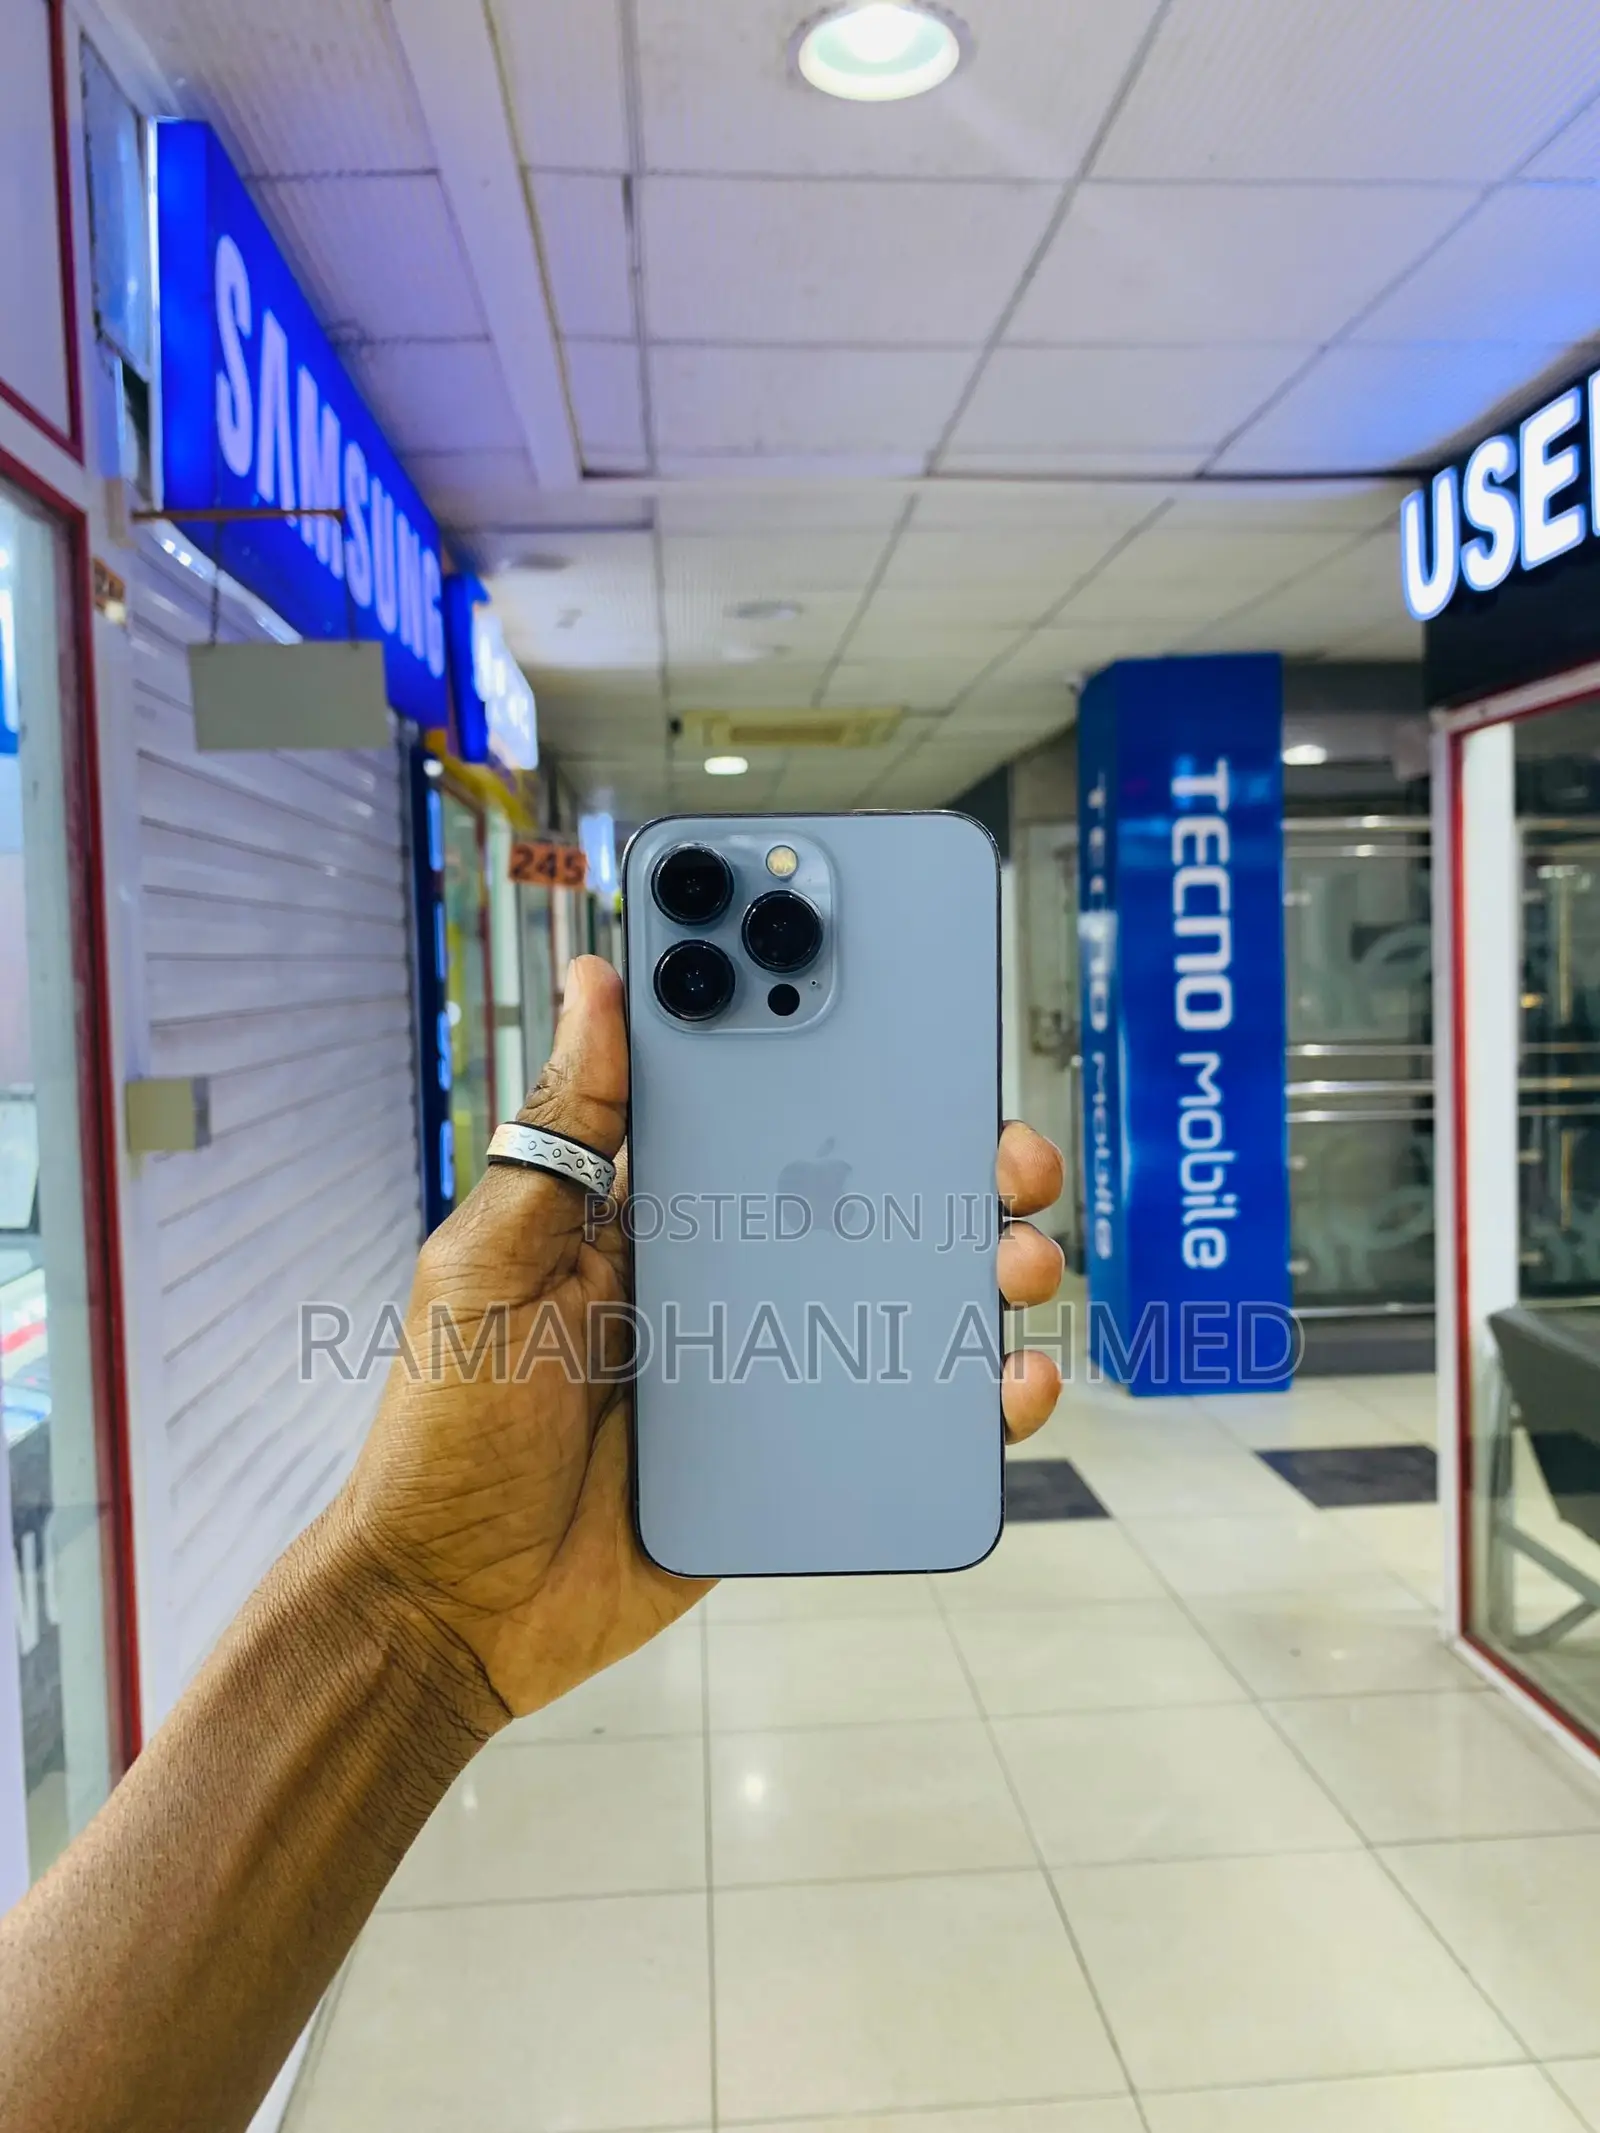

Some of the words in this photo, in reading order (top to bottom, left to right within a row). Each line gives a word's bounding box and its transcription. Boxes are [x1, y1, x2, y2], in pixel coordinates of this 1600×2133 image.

[214, 234, 446, 679] SAMSUNG
[1401, 368, 1600, 621] USE
[1170, 757, 1233, 1031] TECNO
